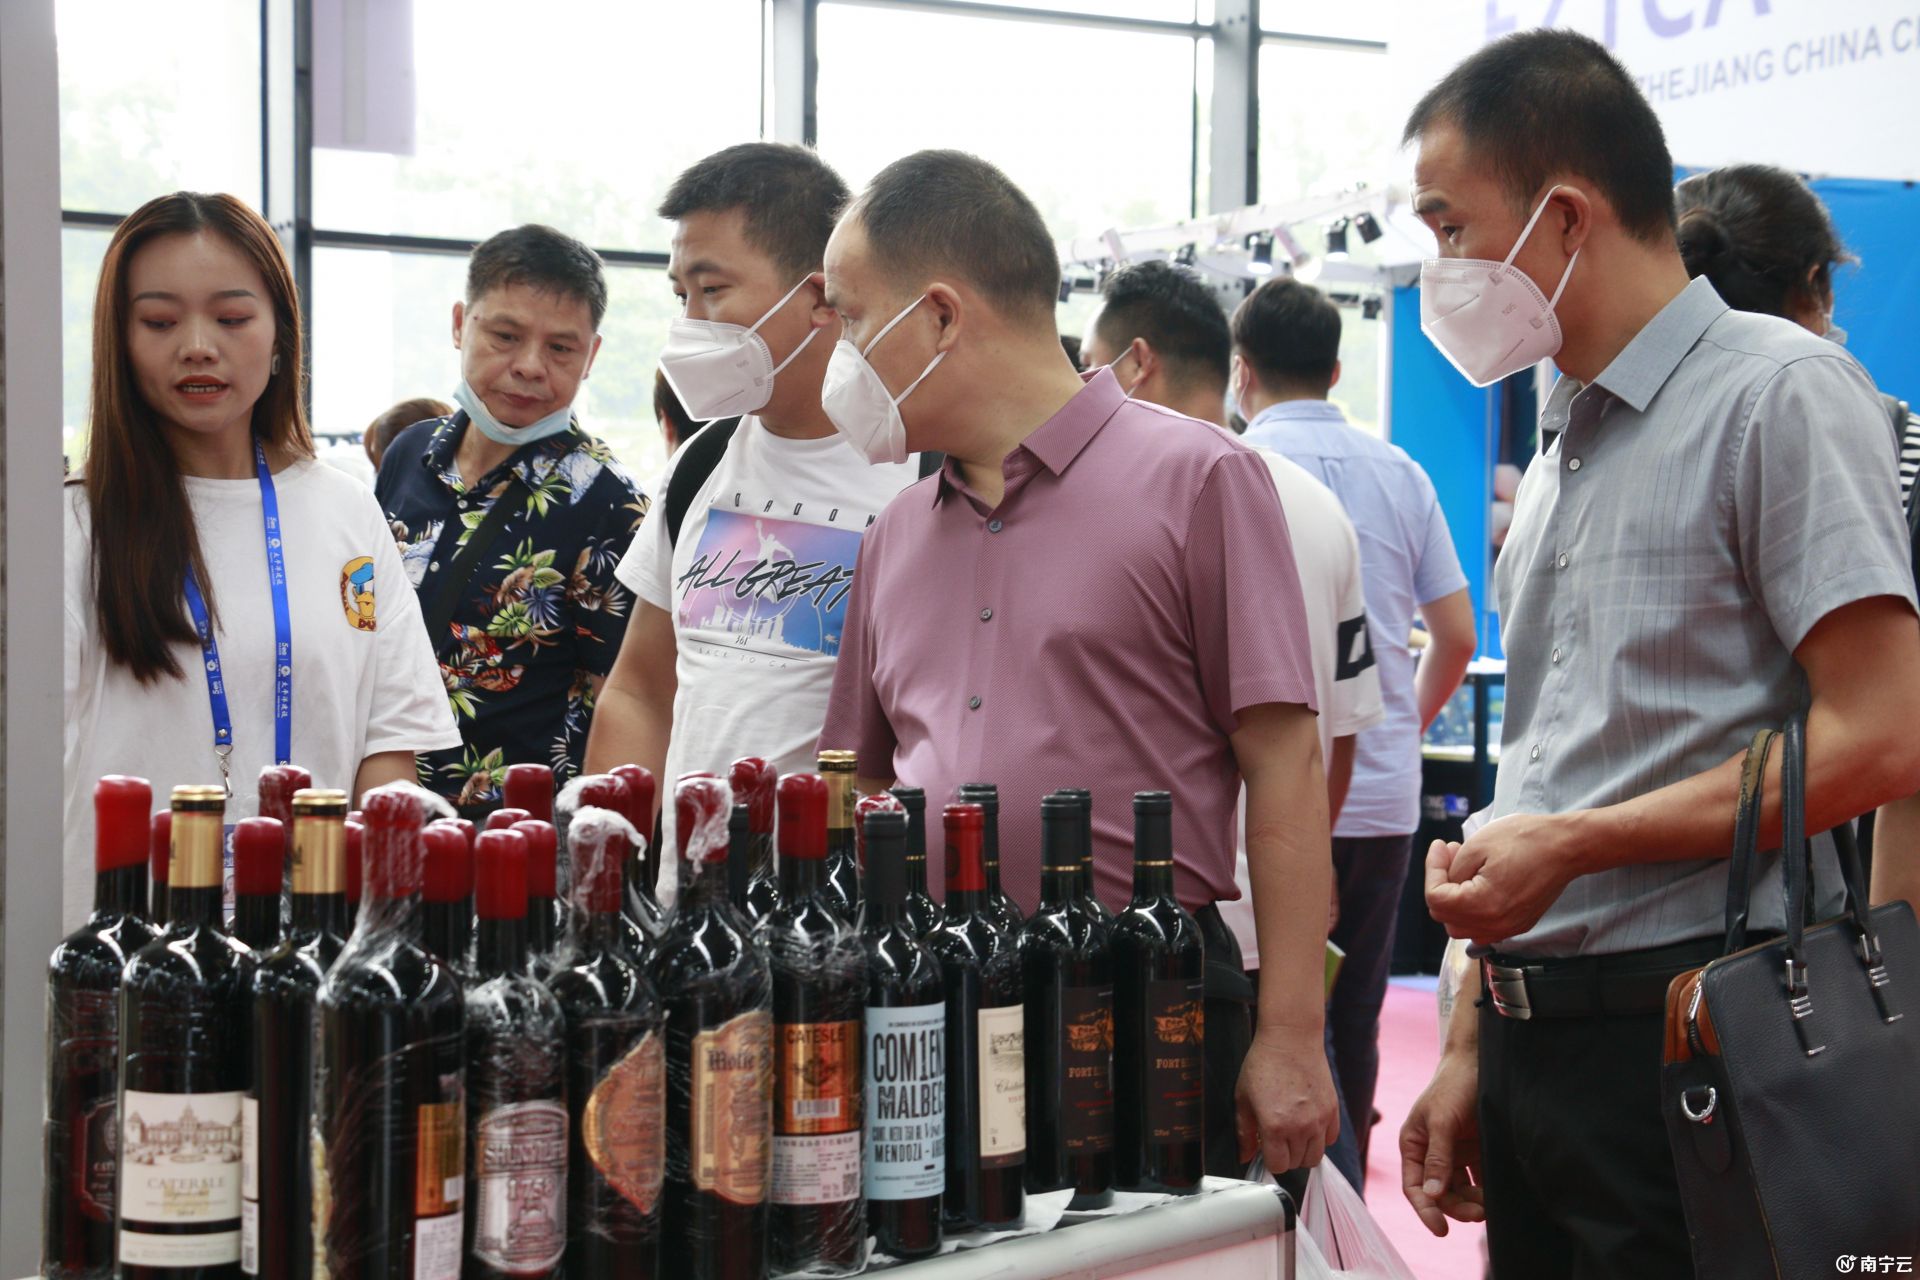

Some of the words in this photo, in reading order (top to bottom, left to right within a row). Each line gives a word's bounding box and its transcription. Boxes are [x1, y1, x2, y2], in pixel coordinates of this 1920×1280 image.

[1783, 26, 1883, 75] CHINA
[677, 550, 741, 600] ALL
[874, 1142, 922, 1163] MENDOZA
